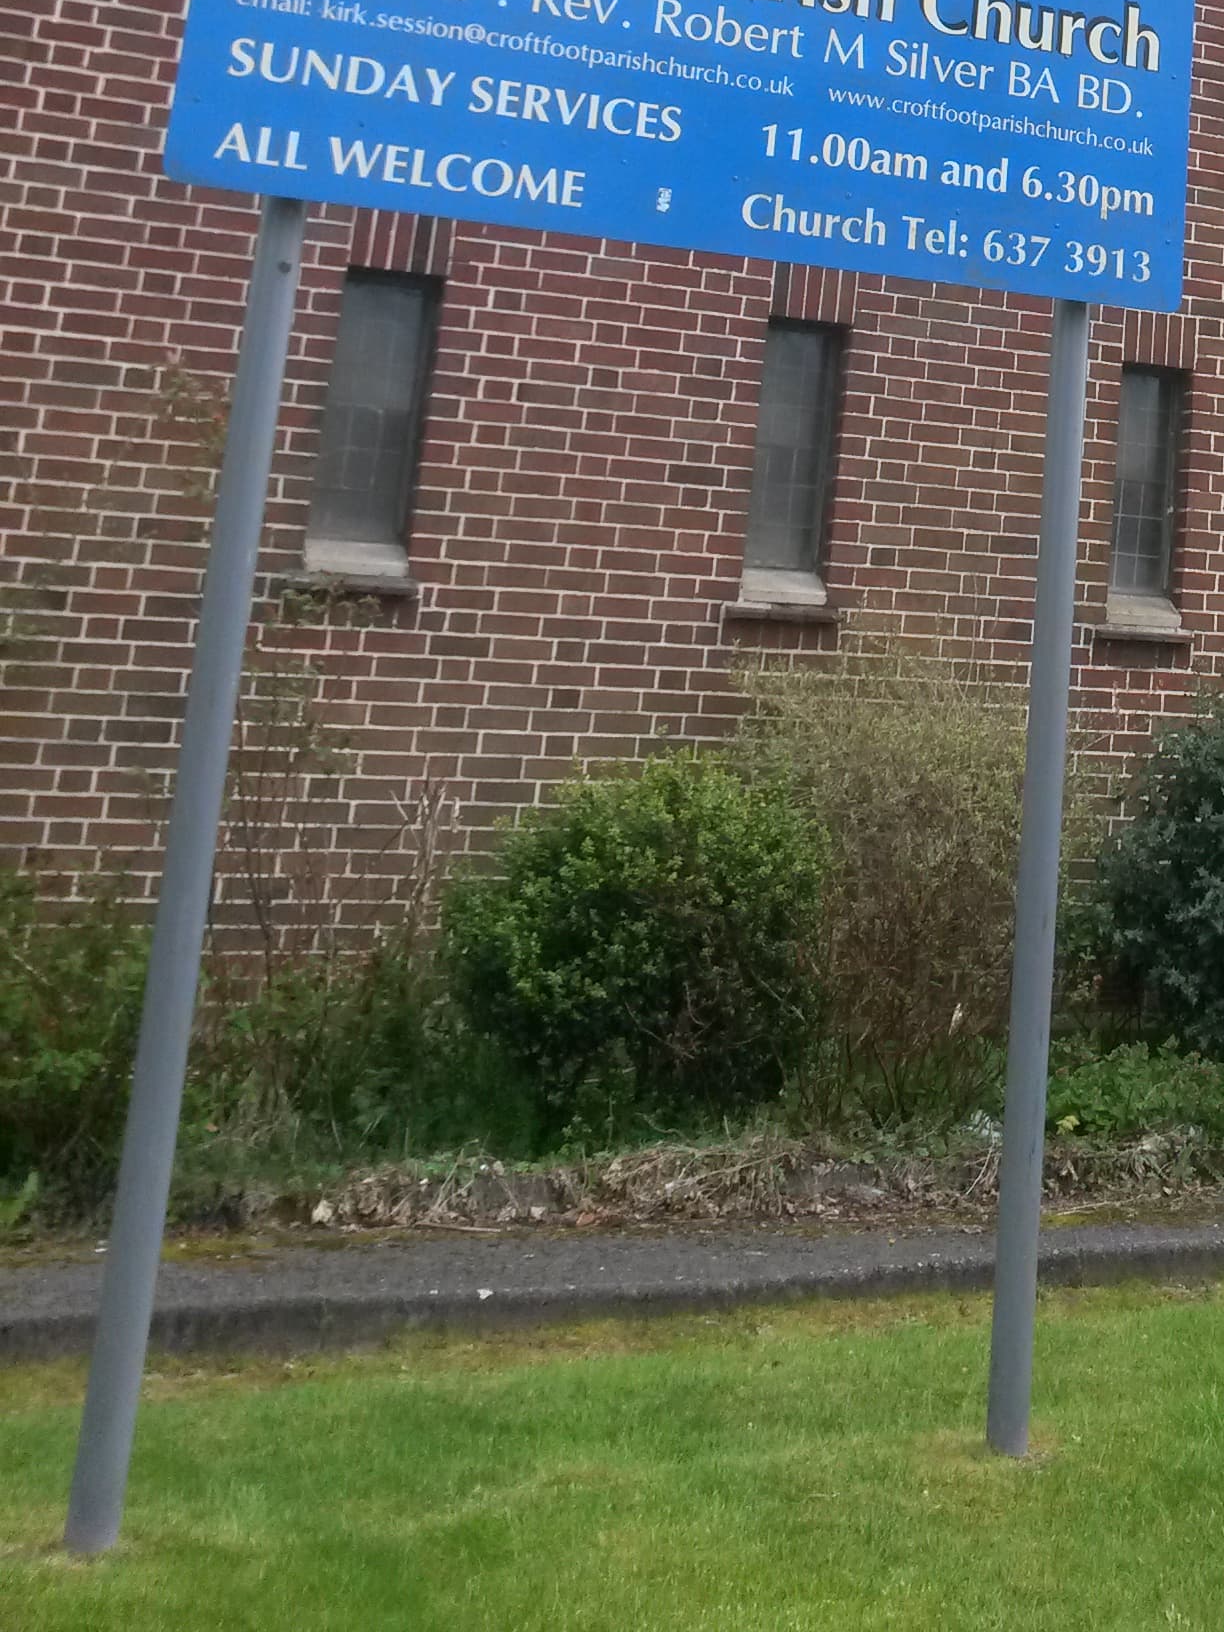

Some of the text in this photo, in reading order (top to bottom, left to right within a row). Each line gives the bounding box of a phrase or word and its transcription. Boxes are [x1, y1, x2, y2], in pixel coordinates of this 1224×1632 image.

[228, 38, 681, 141] SUNDAY SERVICES
[322, 0, 792, 96] kirk.session@croftfootparishchurch.co.uk
[824, 29, 863, 68] M
[886, 40, 994, 89] Silver
[1009, 61, 1059, 103] BA
[1078, 74, 1142, 117] BD.
[214, 123, 585, 207] ALL WELCOME
[829, 89, 1152, 155] www.croftfootparishchurch.co.uk
[763, 125, 1153, 219] 11.00am and 6.30pm
[742, 194, 1150, 281] Church Tel: 637 3913
